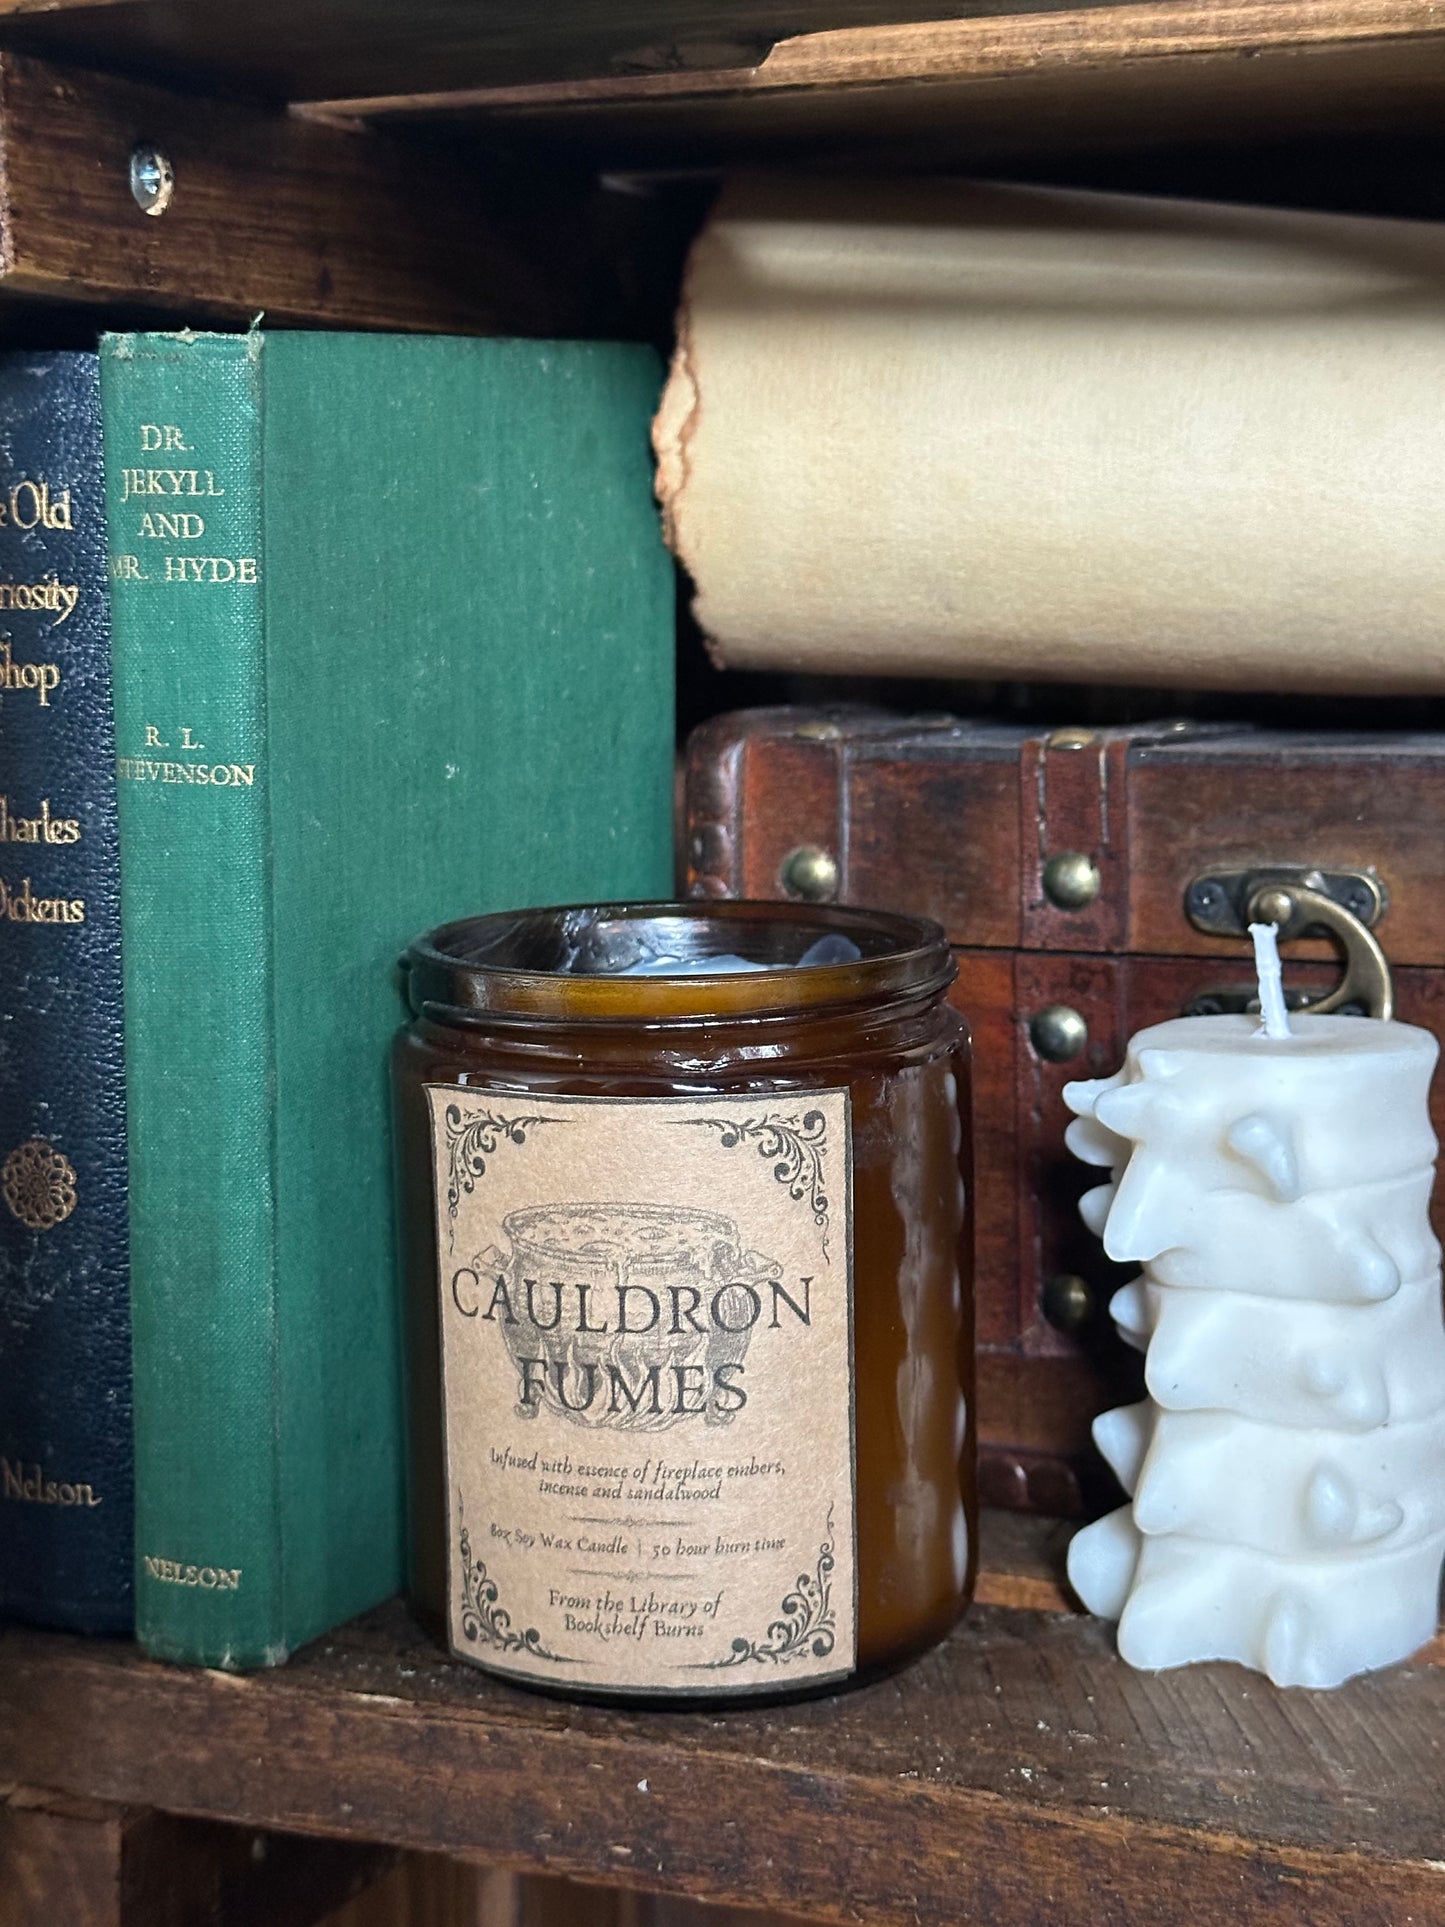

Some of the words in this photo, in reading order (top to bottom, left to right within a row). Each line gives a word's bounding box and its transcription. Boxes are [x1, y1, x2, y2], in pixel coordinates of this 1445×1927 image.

[140, 424, 195, 451] DR.
[120, 468, 225, 502] JEKYLL
[10, 480, 74, 530] Old
[137, 512, 205, 539] AND
[165, 556, 257, 583] HYDE
[145, 725, 170, 747] R.
[181, 727, 205, 749] L.
[452, 1268, 814, 1334] CAULDRON
[516, 1356, 748, 1414] FUMES
[1, 1456, 103, 1507] Nelson
[490, 1446, 538, 1471] Infused
[541, 1454, 573, 1474] with
[577, 1465, 628, 1479] essence
[633, 1459, 651, 1484] of
[653, 1459, 723, 1486] fireplace
[727, 1456, 785, 1477] embers,
[539, 1479, 588, 1497] incense
[592, 1481, 623, 1499] and
[627, 1480, 722, 1501] sandalwood
[540, 1532, 573, 1550] Wax
[577, 1535, 629, 1554] Candle
[652, 1544, 671, 1560] 50
[676, 1537, 710, 1556] hour
[715, 1536, 752, 1555] burn
[754, 1537, 786, 1552] time
[144, 1555, 242, 1590] NELSON
[549, 1589, 591, 1609] From
[596, 1590, 625, 1613] the
[630, 1591, 698, 1618] Library
[703, 1590, 725, 1619] of
[564, 1612, 651, 1643] Bookshelf
[653, 1619, 705, 1638] Burns
